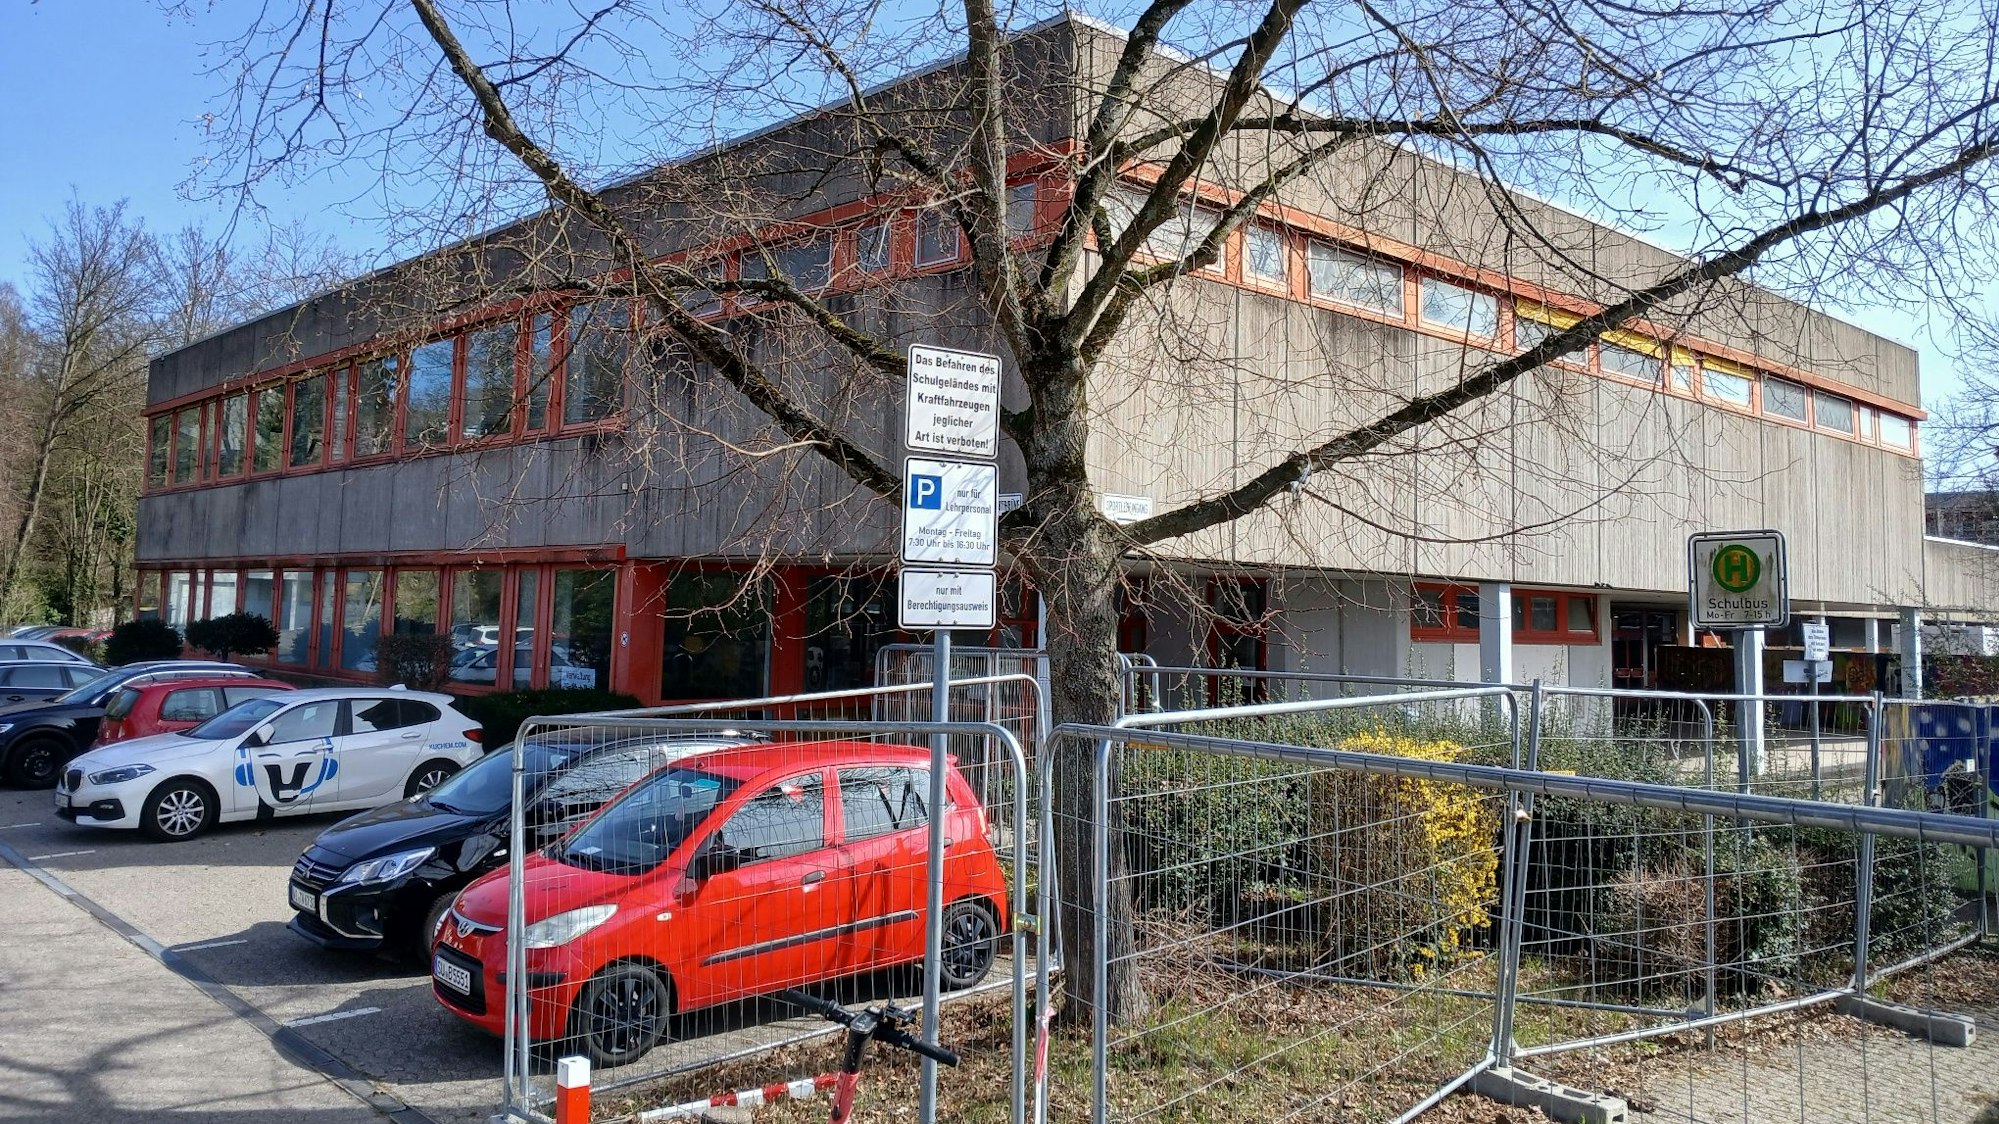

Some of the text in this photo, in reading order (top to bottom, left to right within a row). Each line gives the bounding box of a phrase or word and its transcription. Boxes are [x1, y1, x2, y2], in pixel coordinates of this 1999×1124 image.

[916, 354, 995, 375] Das Befahren des
[913, 373, 996, 394] Schulgeländes mit
[917, 392, 990, 412] Kraftfahrzeugen
[933, 413, 973, 428] jeglicher
[915, 430, 988, 449] Art ist verboten!
[917, 478, 935, 505] P
[957, 489, 981, 498] nur für
[945, 502, 992, 515] Lehrpersonal
[919, 526, 947, 537] Montag
[955, 529, 981, 540] Freitag
[909, 538, 990, 550] 7:30 Uhr bis 16:30 Uhr
[1724, 554, 1748, 582] H
[936, 585, 962, 595] nur mit
[907, 600, 989, 613] Berechtigungsausweis
[1709, 598, 1768, 609] Schulbus
[1707, 611, 1735, 619] Mo-Fr
[1744, 611, 1762, 619] 7-15
